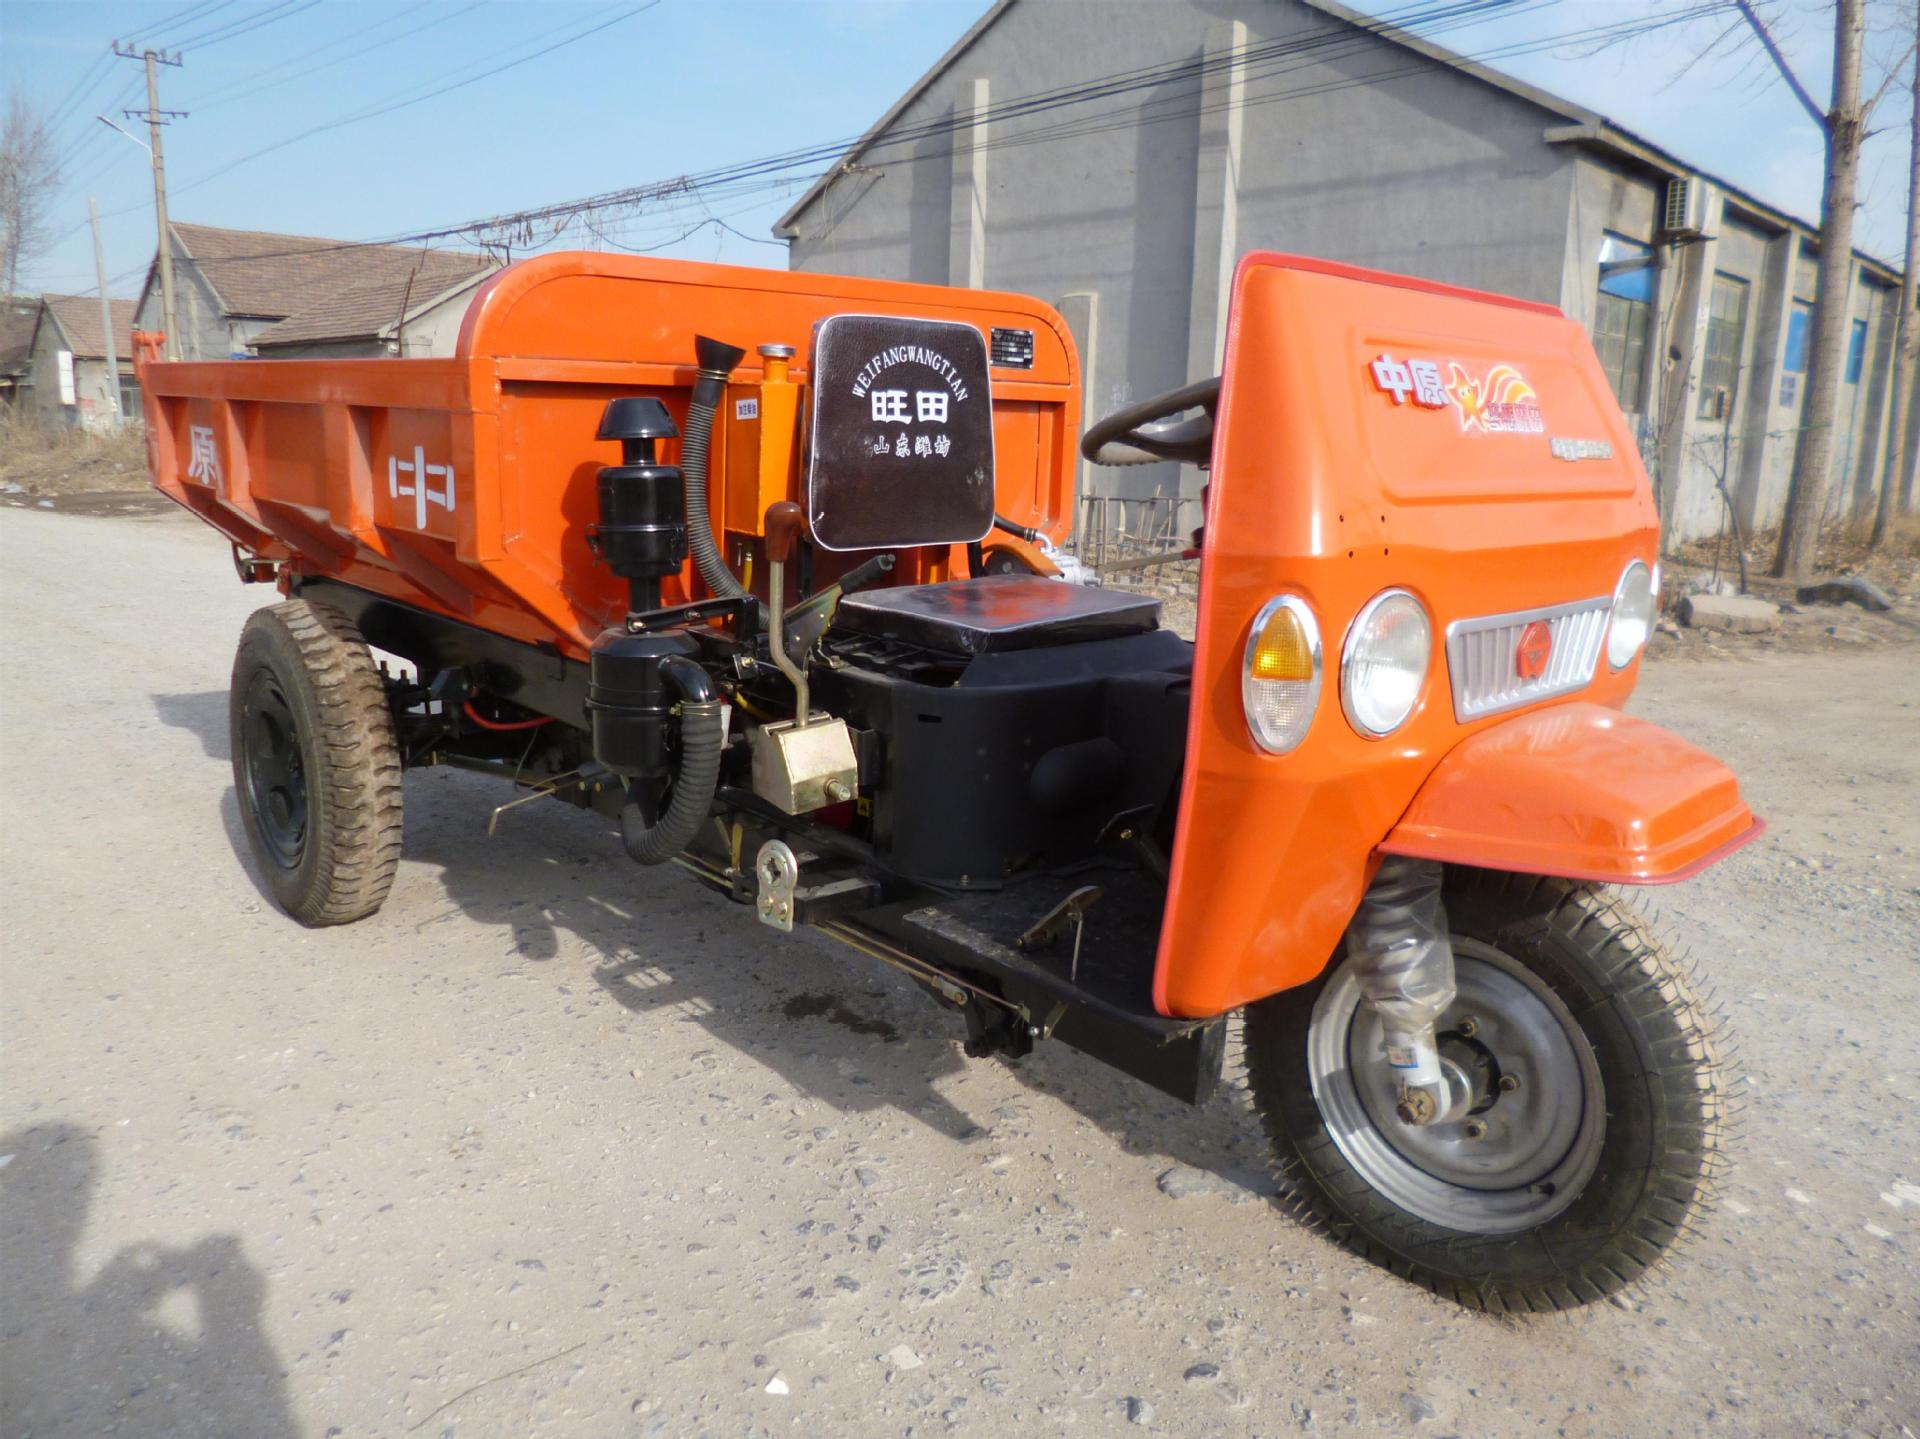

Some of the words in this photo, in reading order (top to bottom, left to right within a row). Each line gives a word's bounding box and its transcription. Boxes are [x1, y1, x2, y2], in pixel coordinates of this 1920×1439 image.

[852, 345, 969, 403] WEIFANGWANGTIAN
[1369, 354, 1450, 409] 中原
[871, 390, 949, 424] 旺田
[873, 432, 951, 458] 山东潍坊
[188, 425, 218, 486] 原
[388, 446, 455, 530] 中
